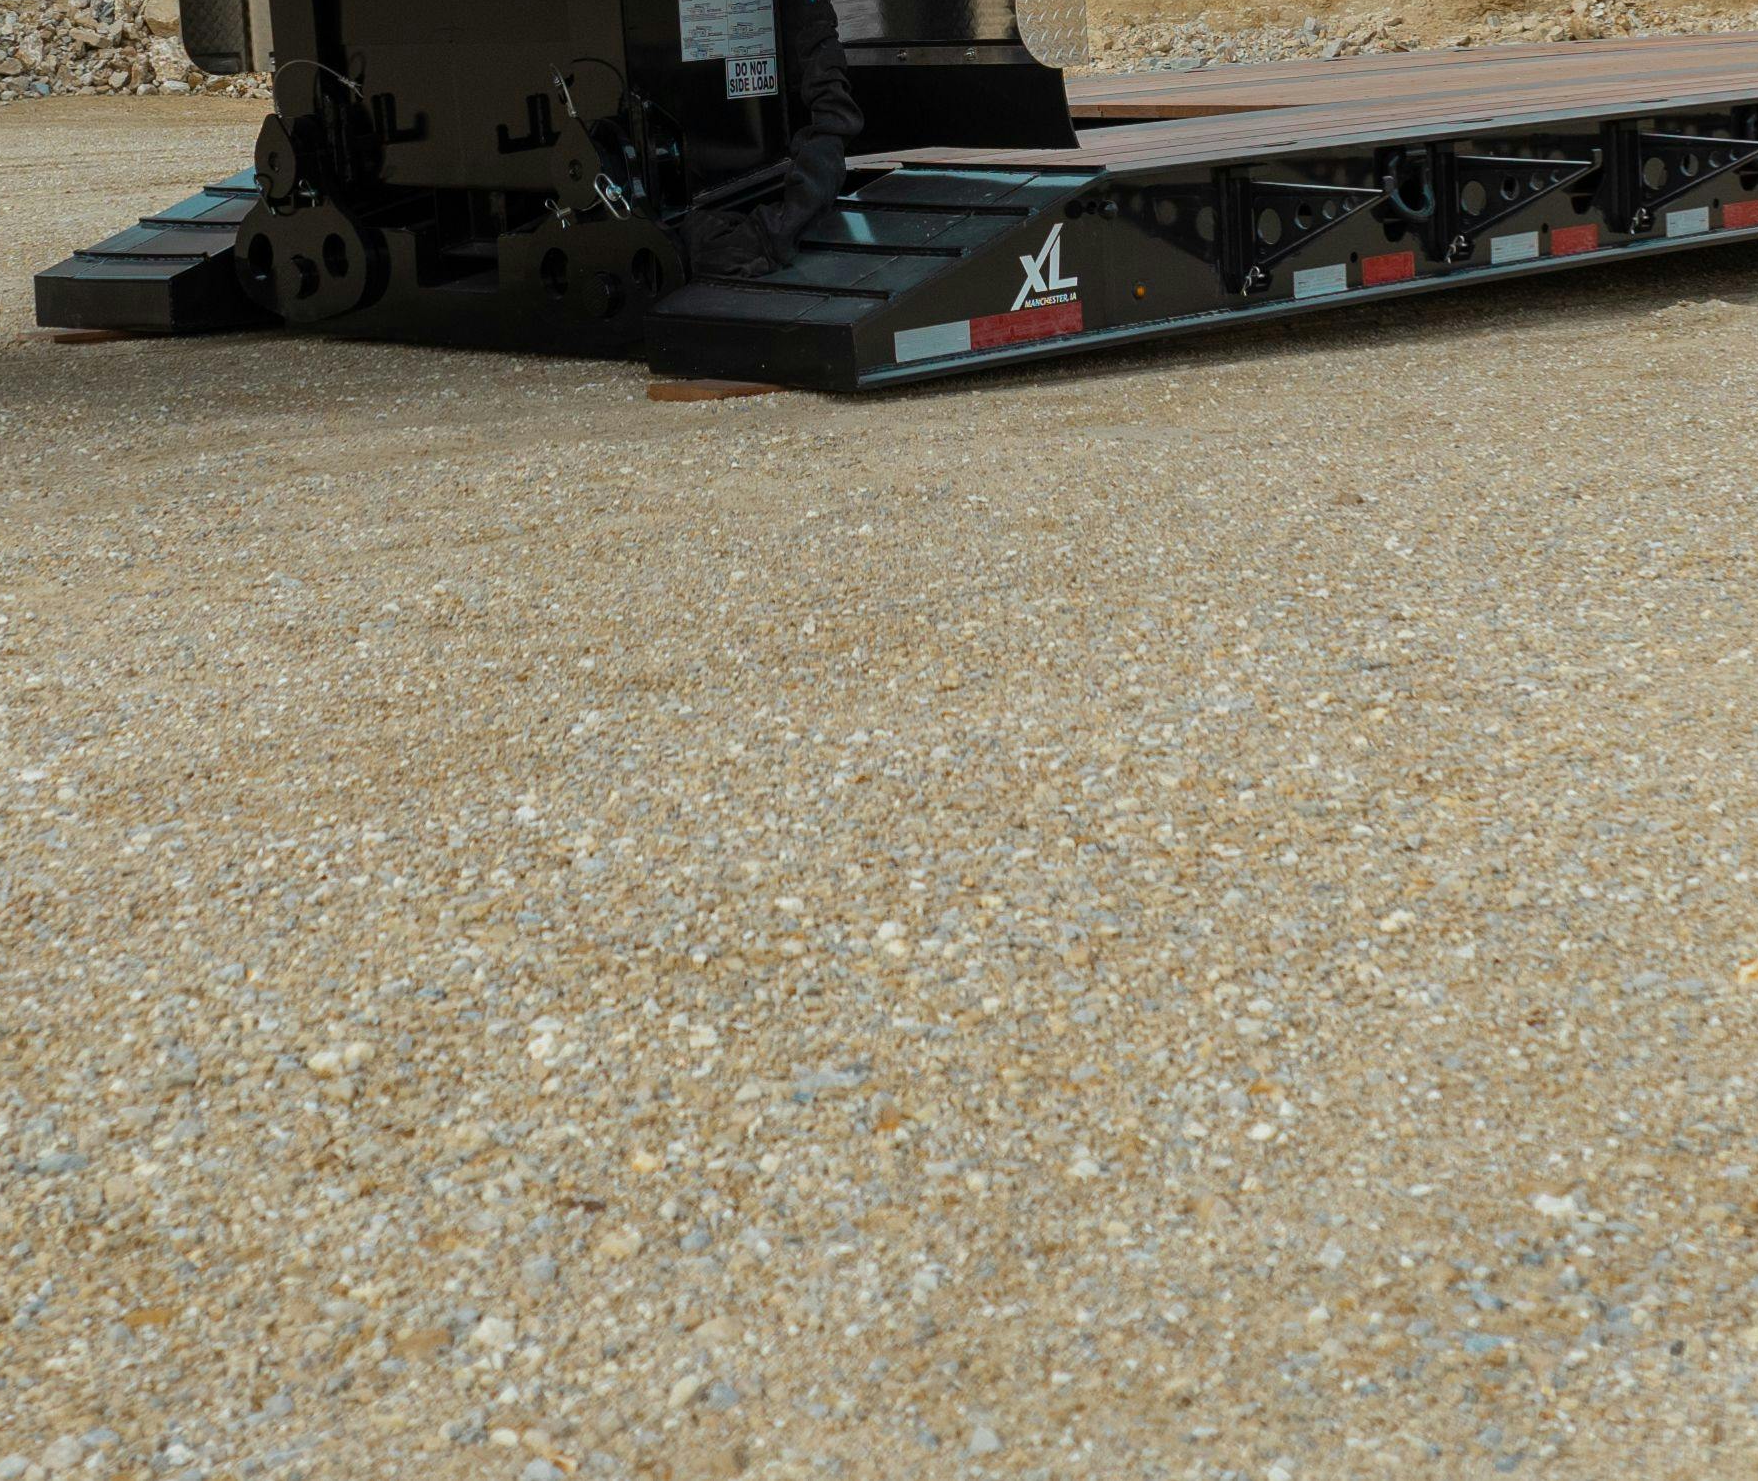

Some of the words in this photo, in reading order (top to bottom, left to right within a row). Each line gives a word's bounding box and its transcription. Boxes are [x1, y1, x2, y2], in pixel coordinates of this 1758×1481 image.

[735, 62, 748, 77] DO
[750, 60, 768, 75] NOT
[730, 78, 750, 93] SIDE
[752, 75, 775, 91] LOAD
[1010, 222, 1078, 312] XL
